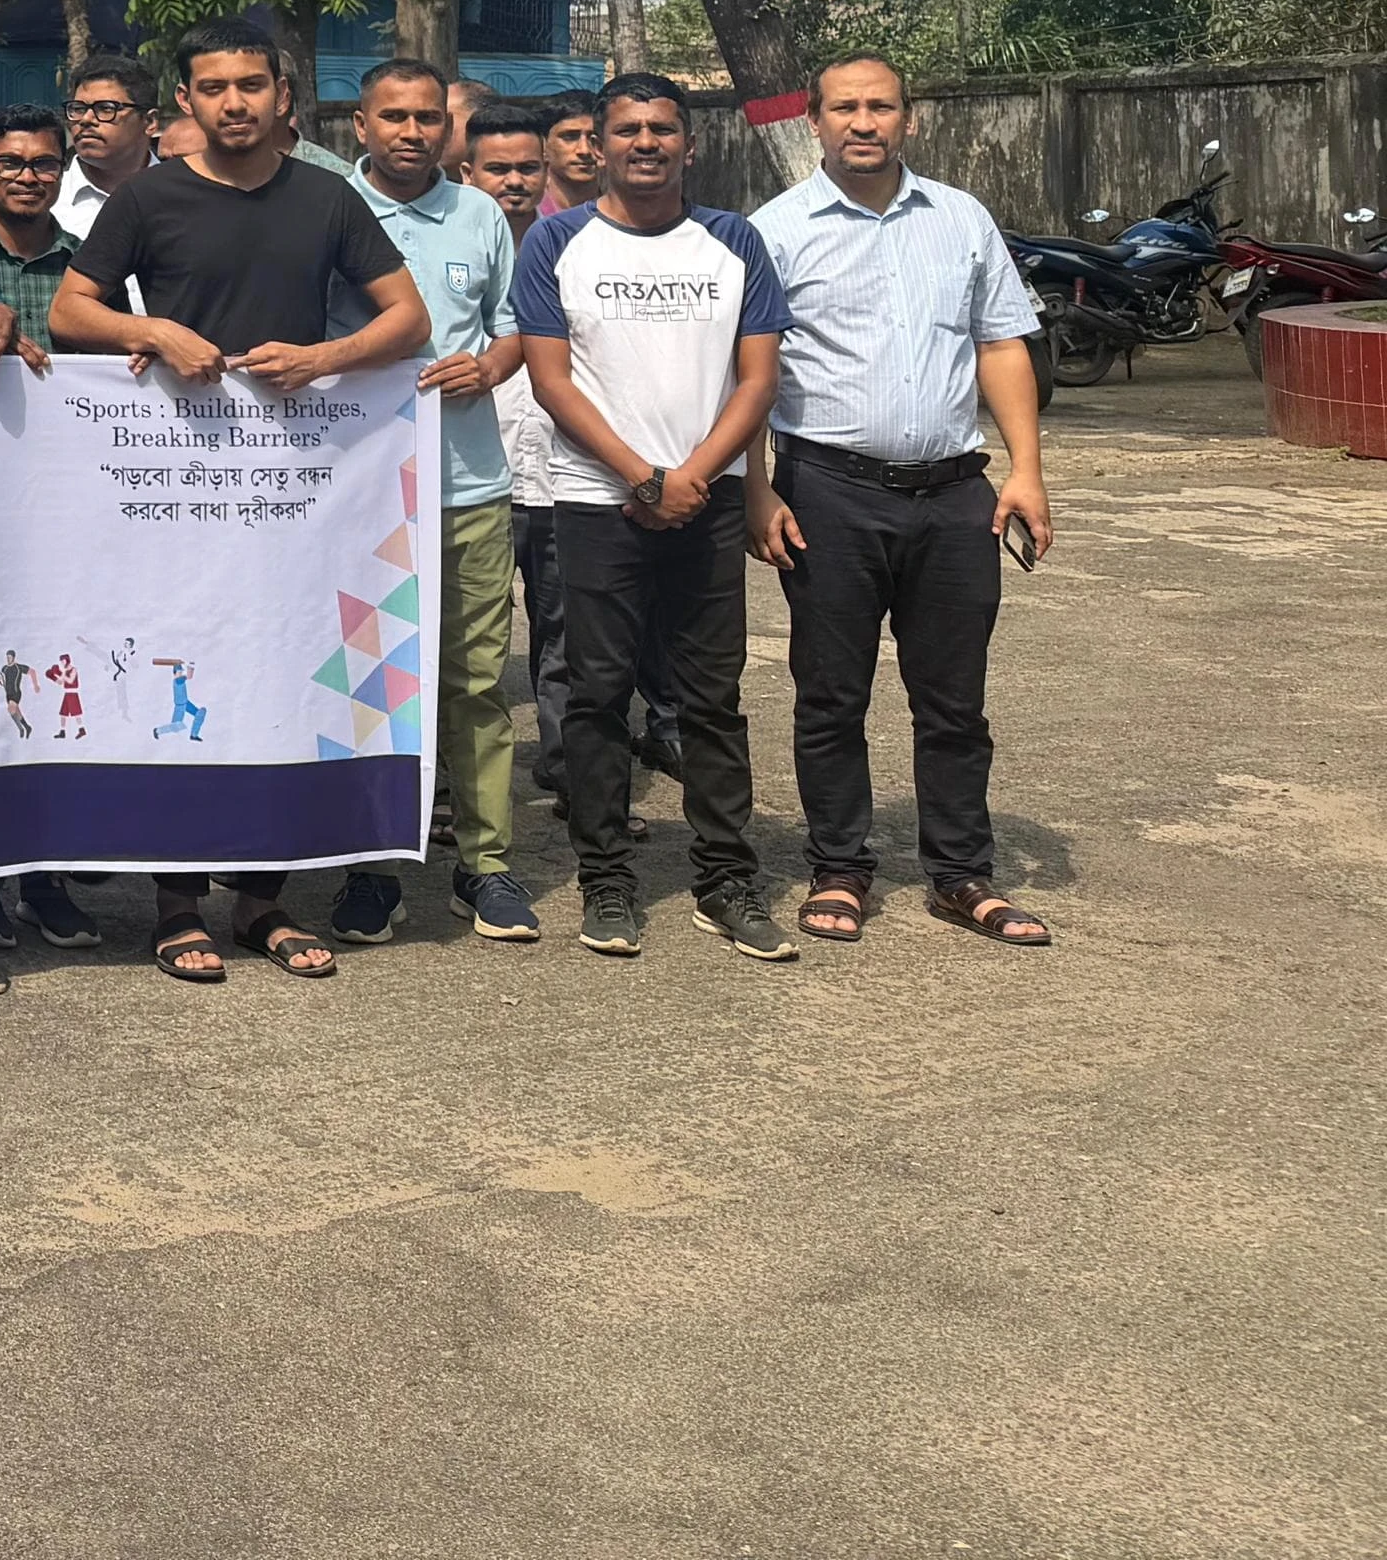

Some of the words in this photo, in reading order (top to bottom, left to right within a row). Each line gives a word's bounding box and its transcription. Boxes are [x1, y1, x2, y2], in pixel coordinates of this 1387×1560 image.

[65, 397, 152, 422] “Sports
[174, 397, 276, 423] Building
[282, 397, 367, 421] Bridges,
[112, 426, 220, 451] Breaking
[228, 426, 329, 447] Barriers”
[179, 460, 243, 491] ক্রীড়ায়
[250, 467, 291, 493] সেতু
[296, 467, 333, 487] বন্ধন
[119, 502, 181, 522] করবো
[189, 502, 229, 522] বাধা
